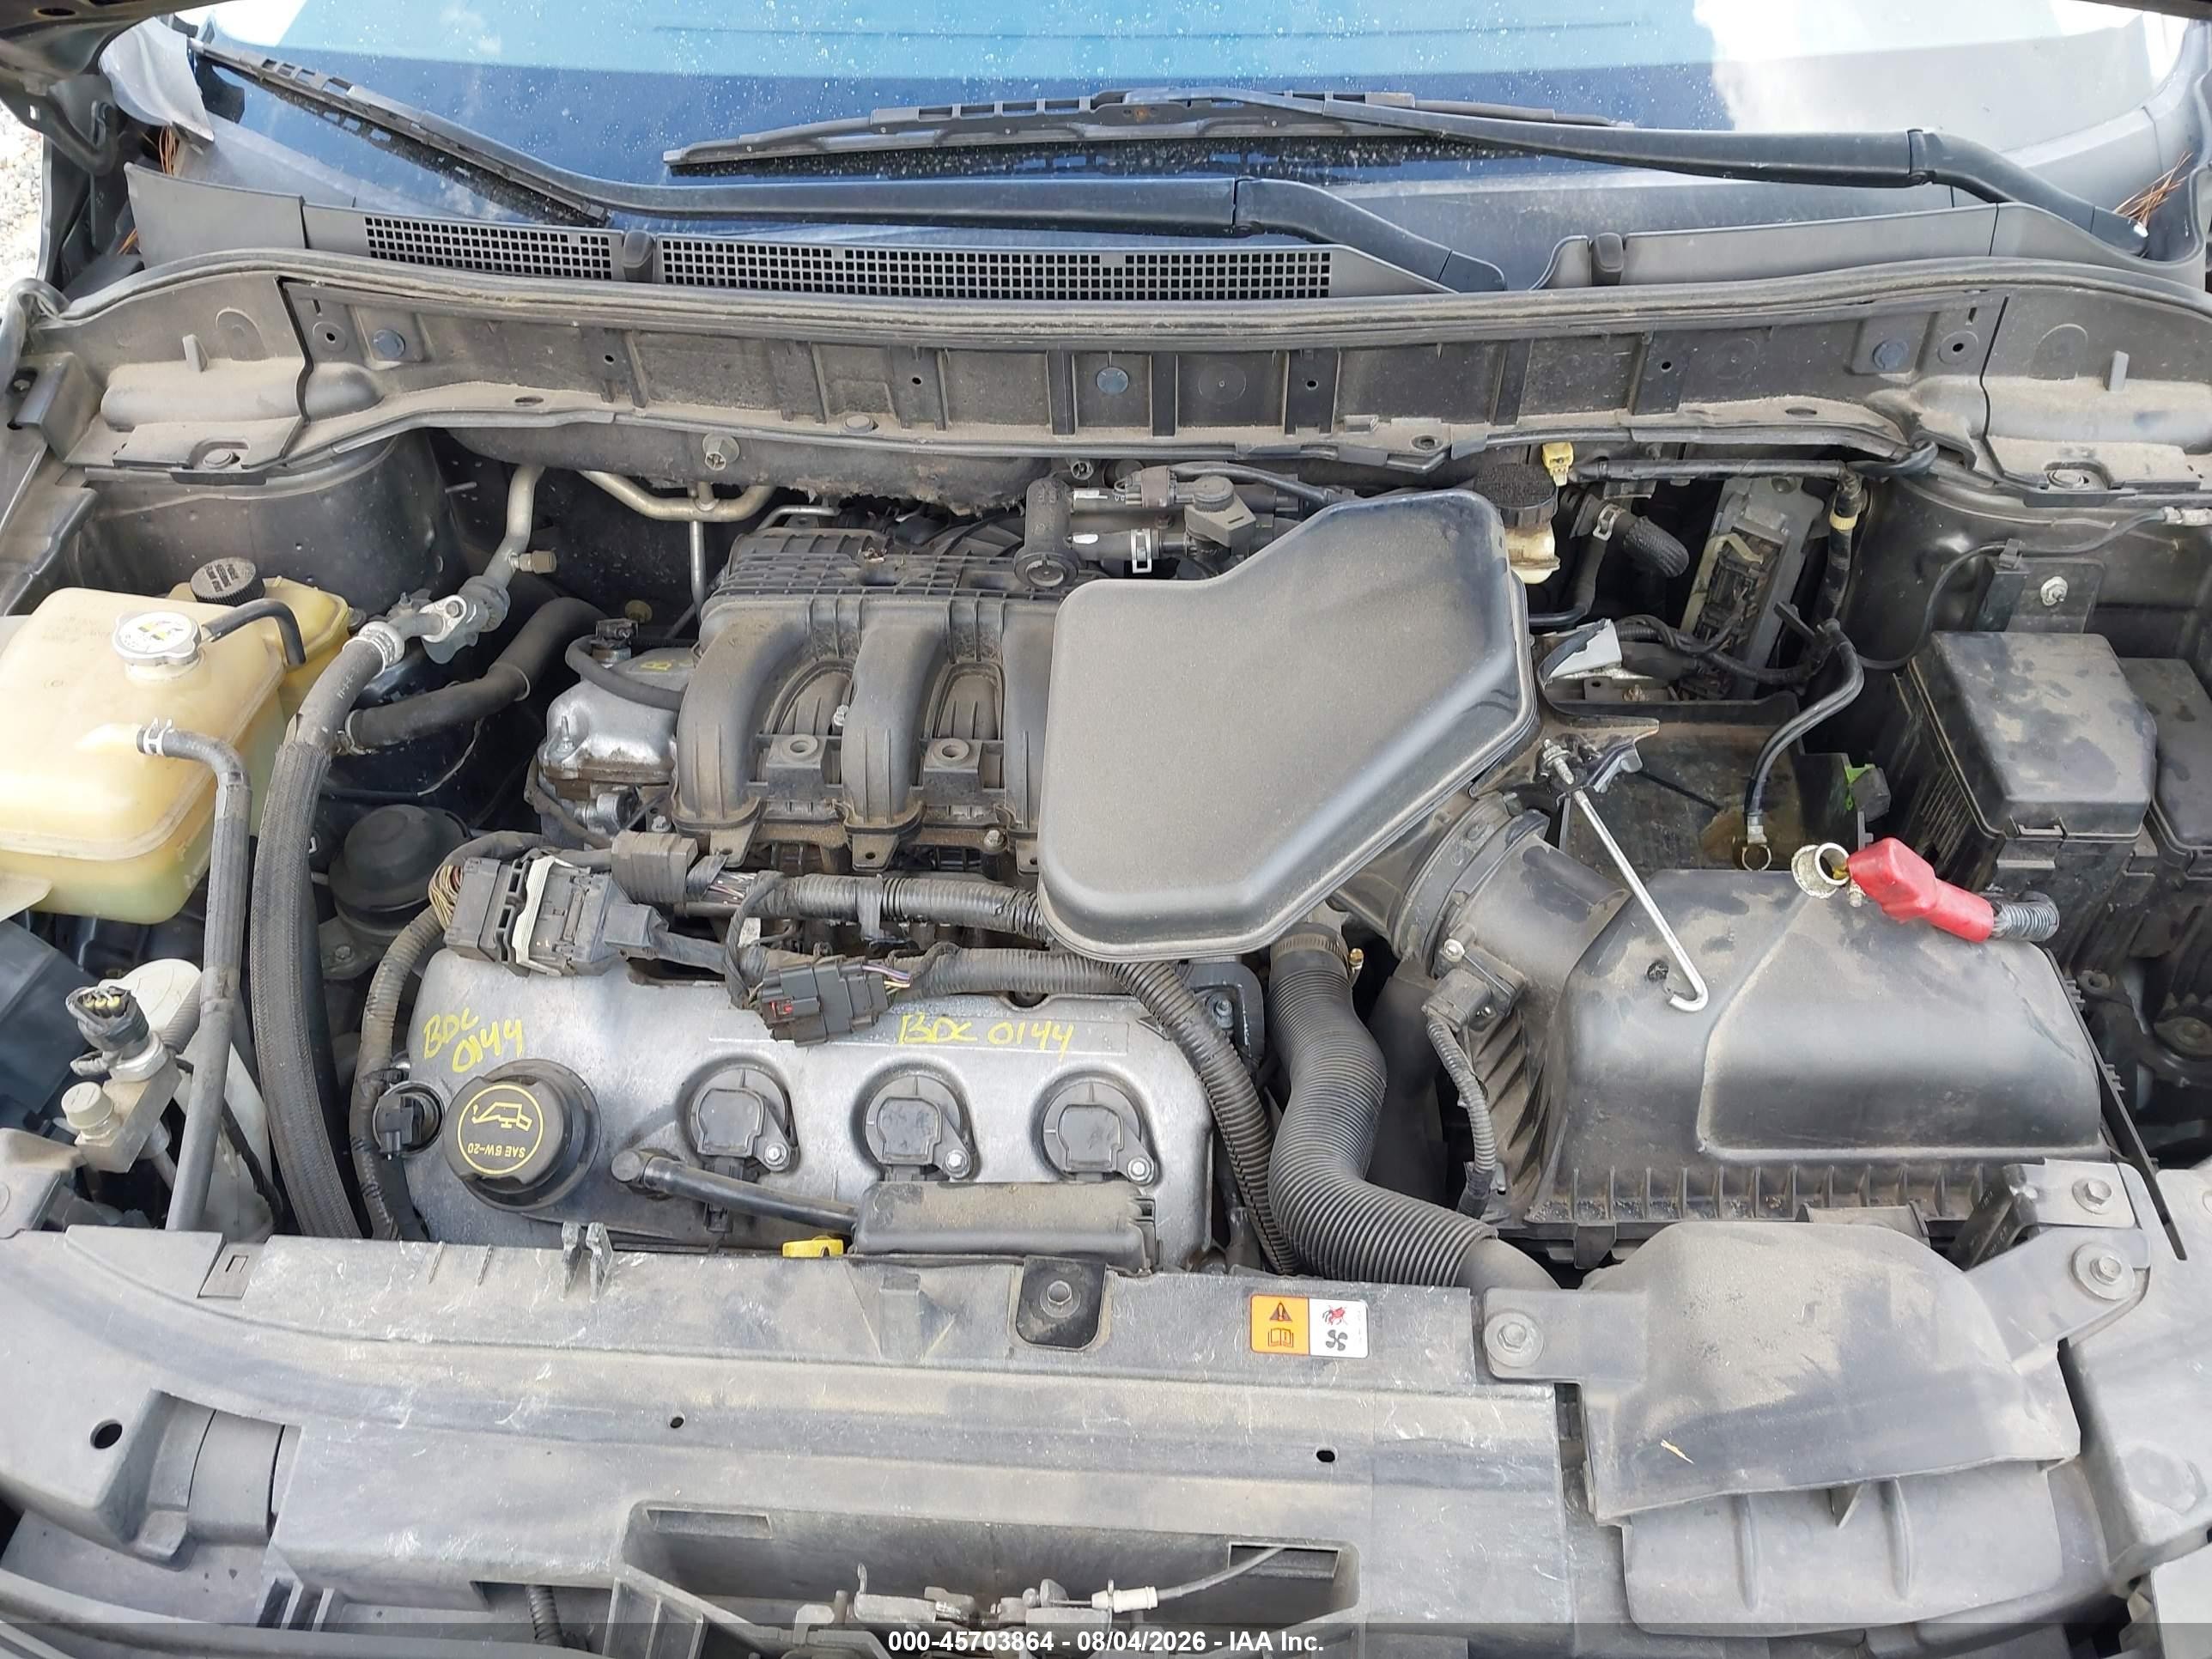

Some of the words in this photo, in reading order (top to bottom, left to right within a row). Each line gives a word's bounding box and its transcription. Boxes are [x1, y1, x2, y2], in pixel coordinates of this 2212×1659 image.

[452, 1018, 524, 1073] 0144
[988, 1020, 1074, 1063] 0144
[504, 1145, 526, 1159] SAE
